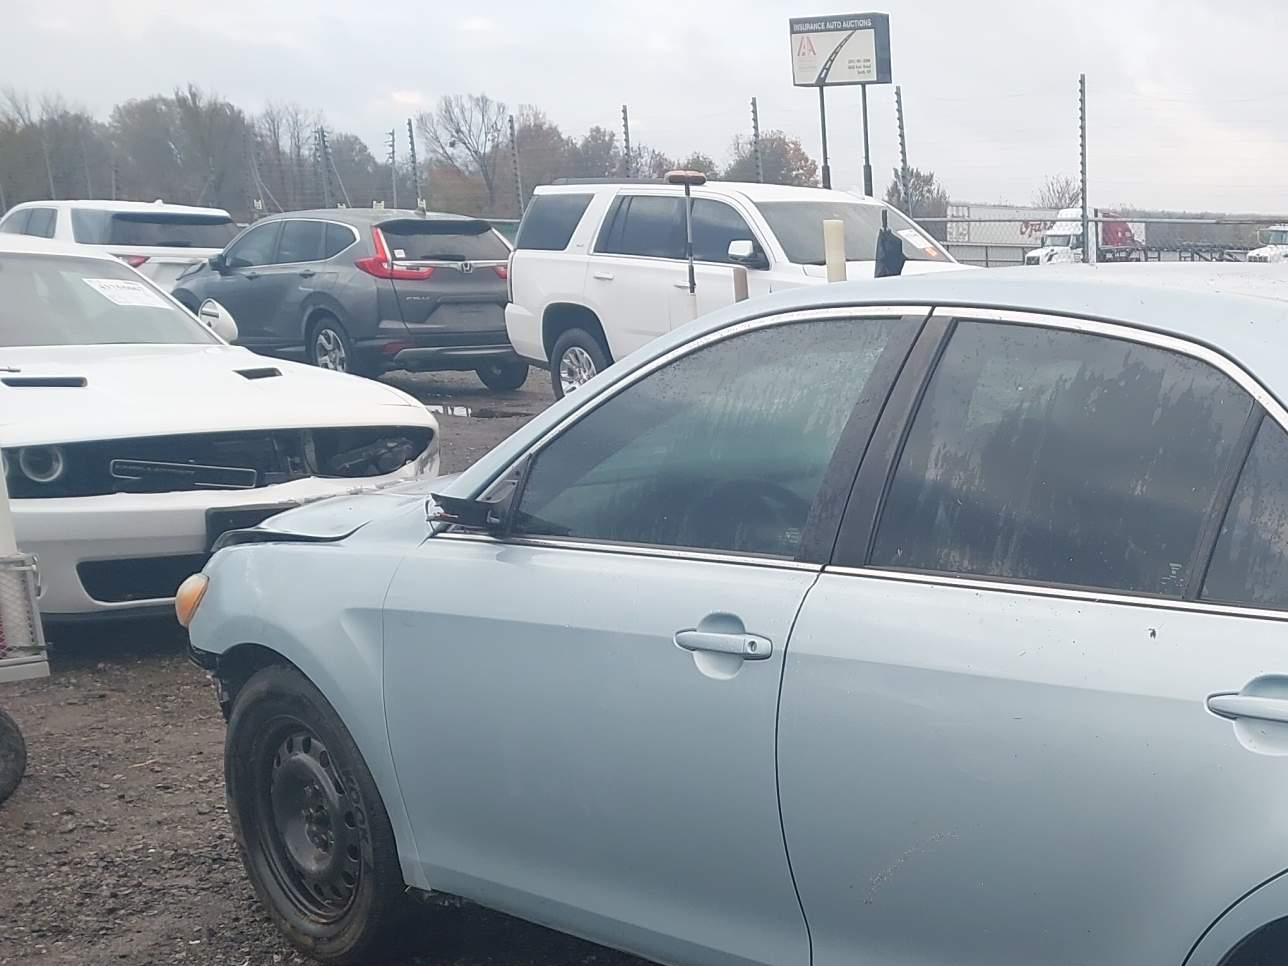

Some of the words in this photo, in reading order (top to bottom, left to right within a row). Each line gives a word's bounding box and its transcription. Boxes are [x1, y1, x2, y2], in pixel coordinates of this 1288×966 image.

[793, 22, 825, 32] INSURANCE
[826, 20, 842, 29] AUTO
[842, 18, 872, 28] AUCTIONS
